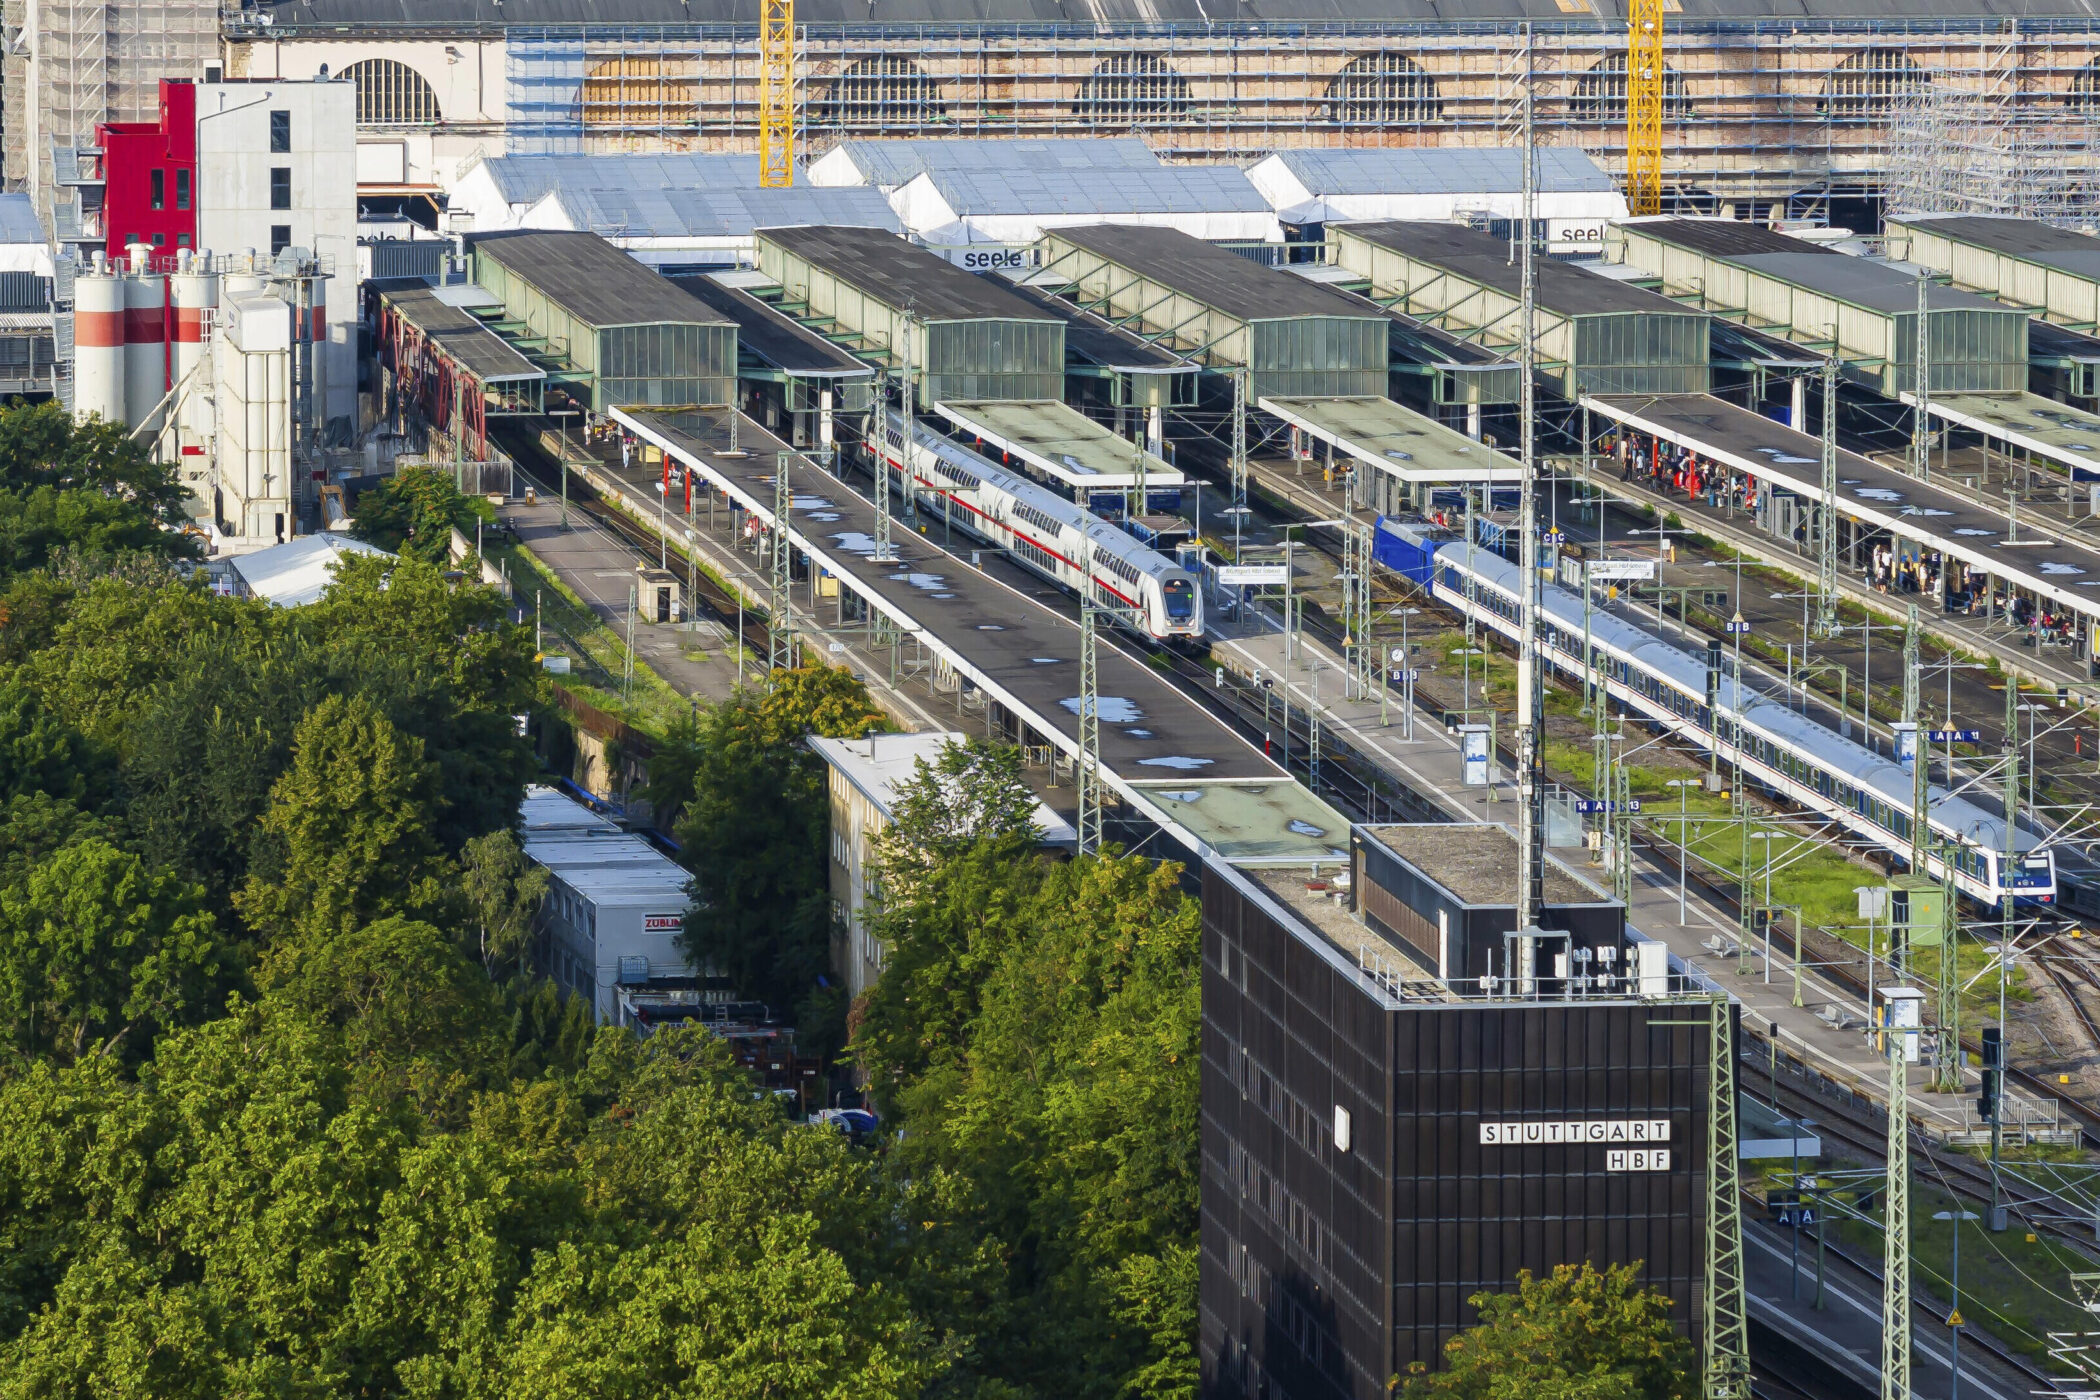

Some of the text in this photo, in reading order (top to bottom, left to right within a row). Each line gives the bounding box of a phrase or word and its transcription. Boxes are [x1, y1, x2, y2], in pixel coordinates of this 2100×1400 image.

[965, 249, 1021, 267] seele
[1558, 533, 1565, 542] C
[1727, 622, 1750, 631] B B
[1393, 671, 1401, 680] B
[1937, 731, 1945, 740] A
[1954, 731, 1962, 740] A
[1577, 800, 1640, 811] 14 A 13
[1486, 1122, 1665, 1142] STUTTGART
[1611, 1152, 1665, 1169] HBF
[1803, 1209, 1812, 1222] A
